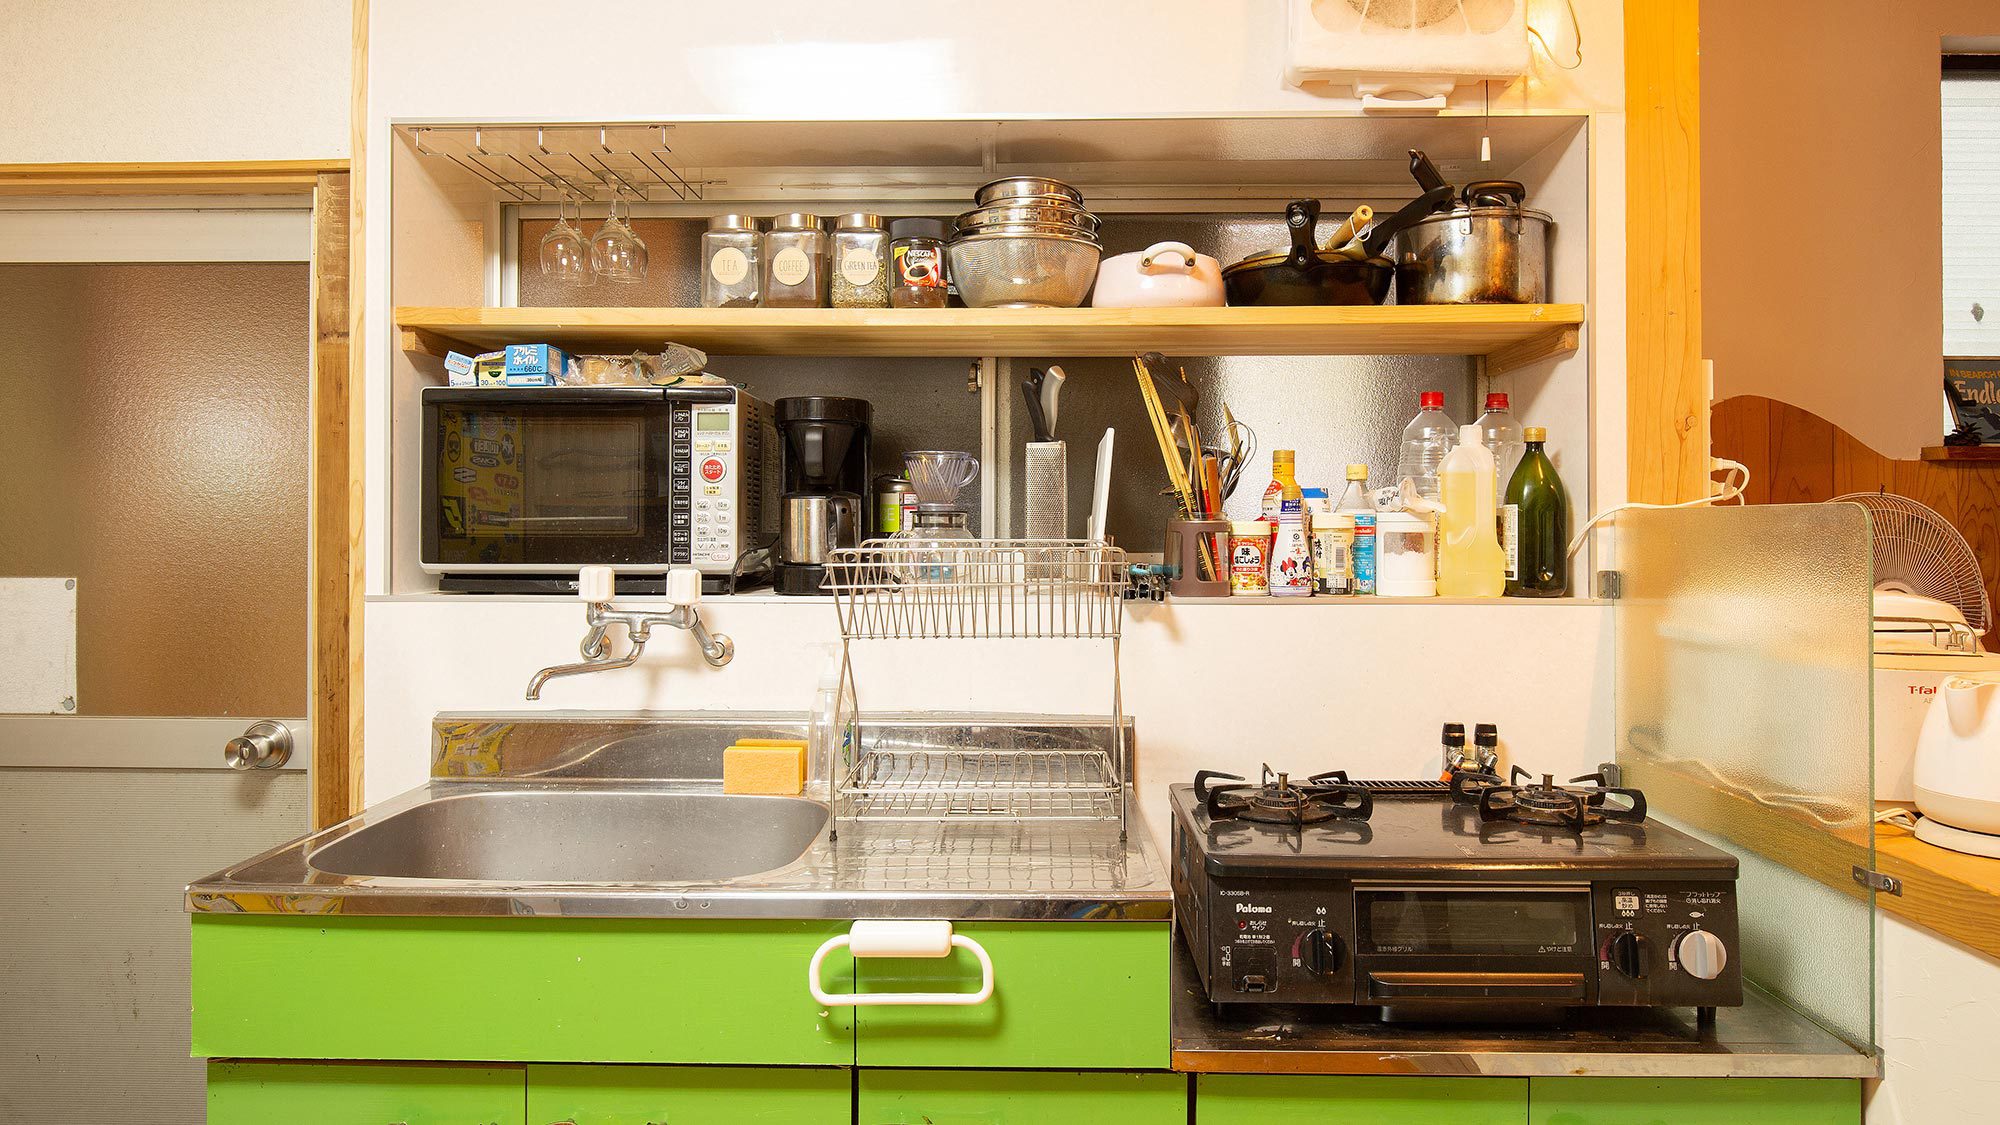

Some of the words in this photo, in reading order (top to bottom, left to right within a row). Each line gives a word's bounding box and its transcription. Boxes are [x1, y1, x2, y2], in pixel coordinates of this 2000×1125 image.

[722, 260, 738, 271] TEA
[778, 260, 804, 272] COFFEE
[844, 260, 865, 272] GREEN
[866, 260, 877, 271] TEA
[513, 346, 538, 356] アルミ
[513, 356, 538, 366] ホイル
[1949, 368, 1960, 377] IN
[1961, 370, 1997, 379] SEARCH
[1241, 547, 1251, 556] 味
[1235, 903, 1273, 913] Paloma
[1317, 919, 1326, 928] 止
[1624, 921, 1634, 930] 止
[1692, 922, 1701, 931] 止
